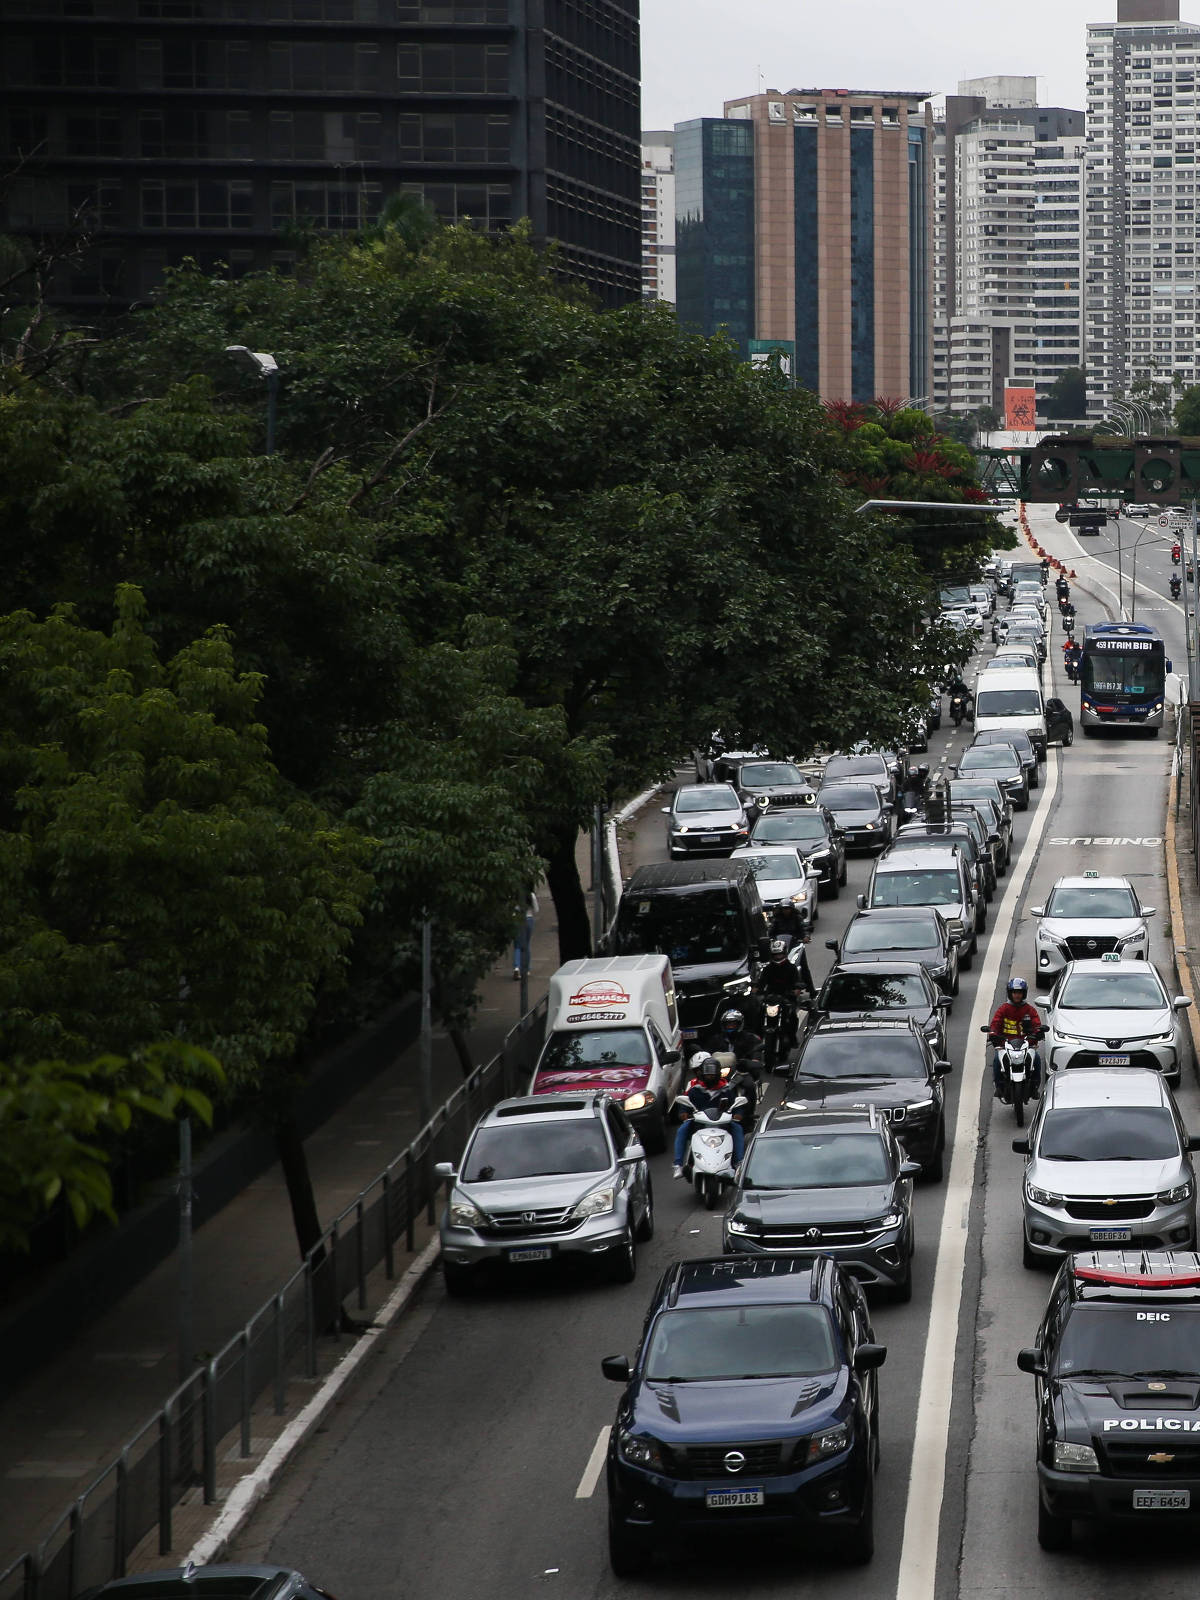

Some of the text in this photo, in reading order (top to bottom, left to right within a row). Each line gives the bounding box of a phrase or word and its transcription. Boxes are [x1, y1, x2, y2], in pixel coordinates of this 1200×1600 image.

[1107, 641, 1132, 649] ITAIM
[1133, 642, 1153, 650] BIBI
[1048, 837, 1162, 848] ÔNIBUS
[570, 994, 629, 1004] MORAMASSA
[1136, 1312, 1170, 1322] DEIC
